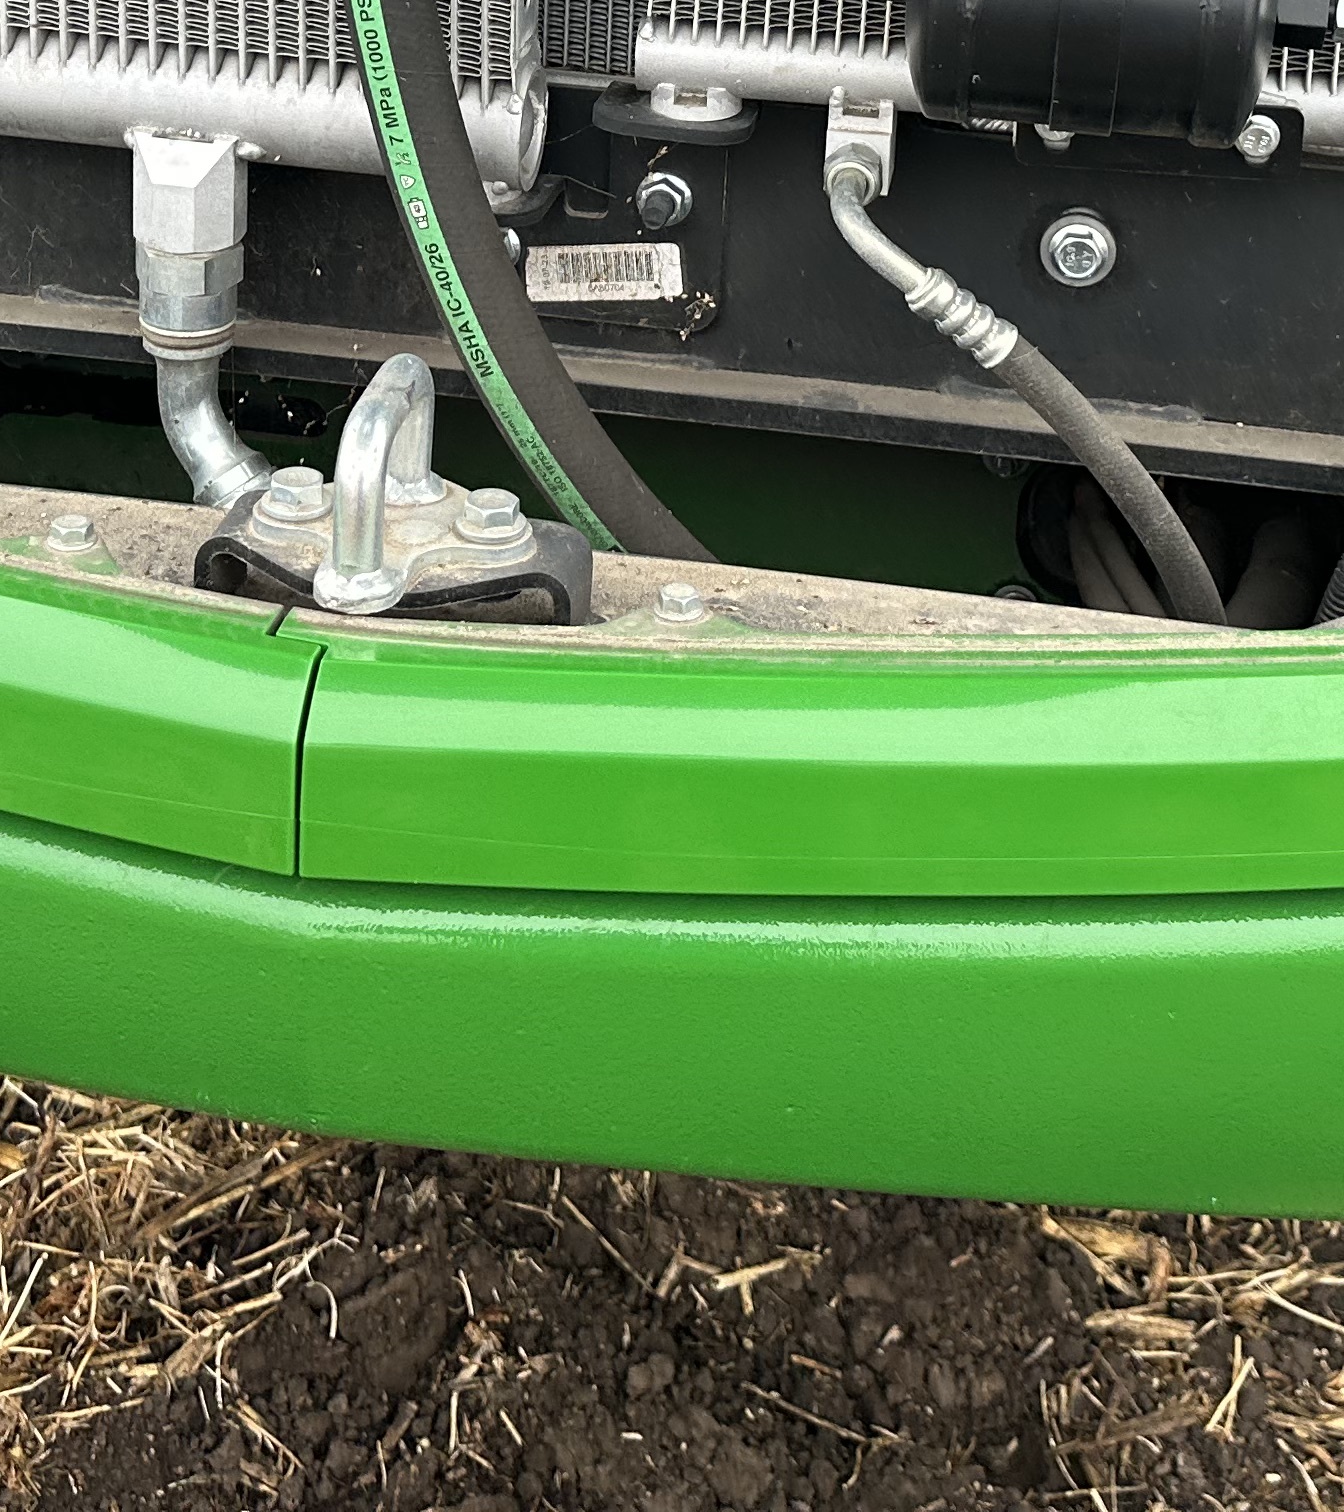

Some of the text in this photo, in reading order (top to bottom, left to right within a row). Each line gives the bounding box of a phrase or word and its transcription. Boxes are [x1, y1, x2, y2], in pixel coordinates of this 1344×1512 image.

[364, 29, 388, 81] (1000
[379, 87, 400, 128] MPa
[389, 135, 404, 146] 7
[424, 242, 466, 317] IC-40/26
[457, 319, 494, 379] MSHA
